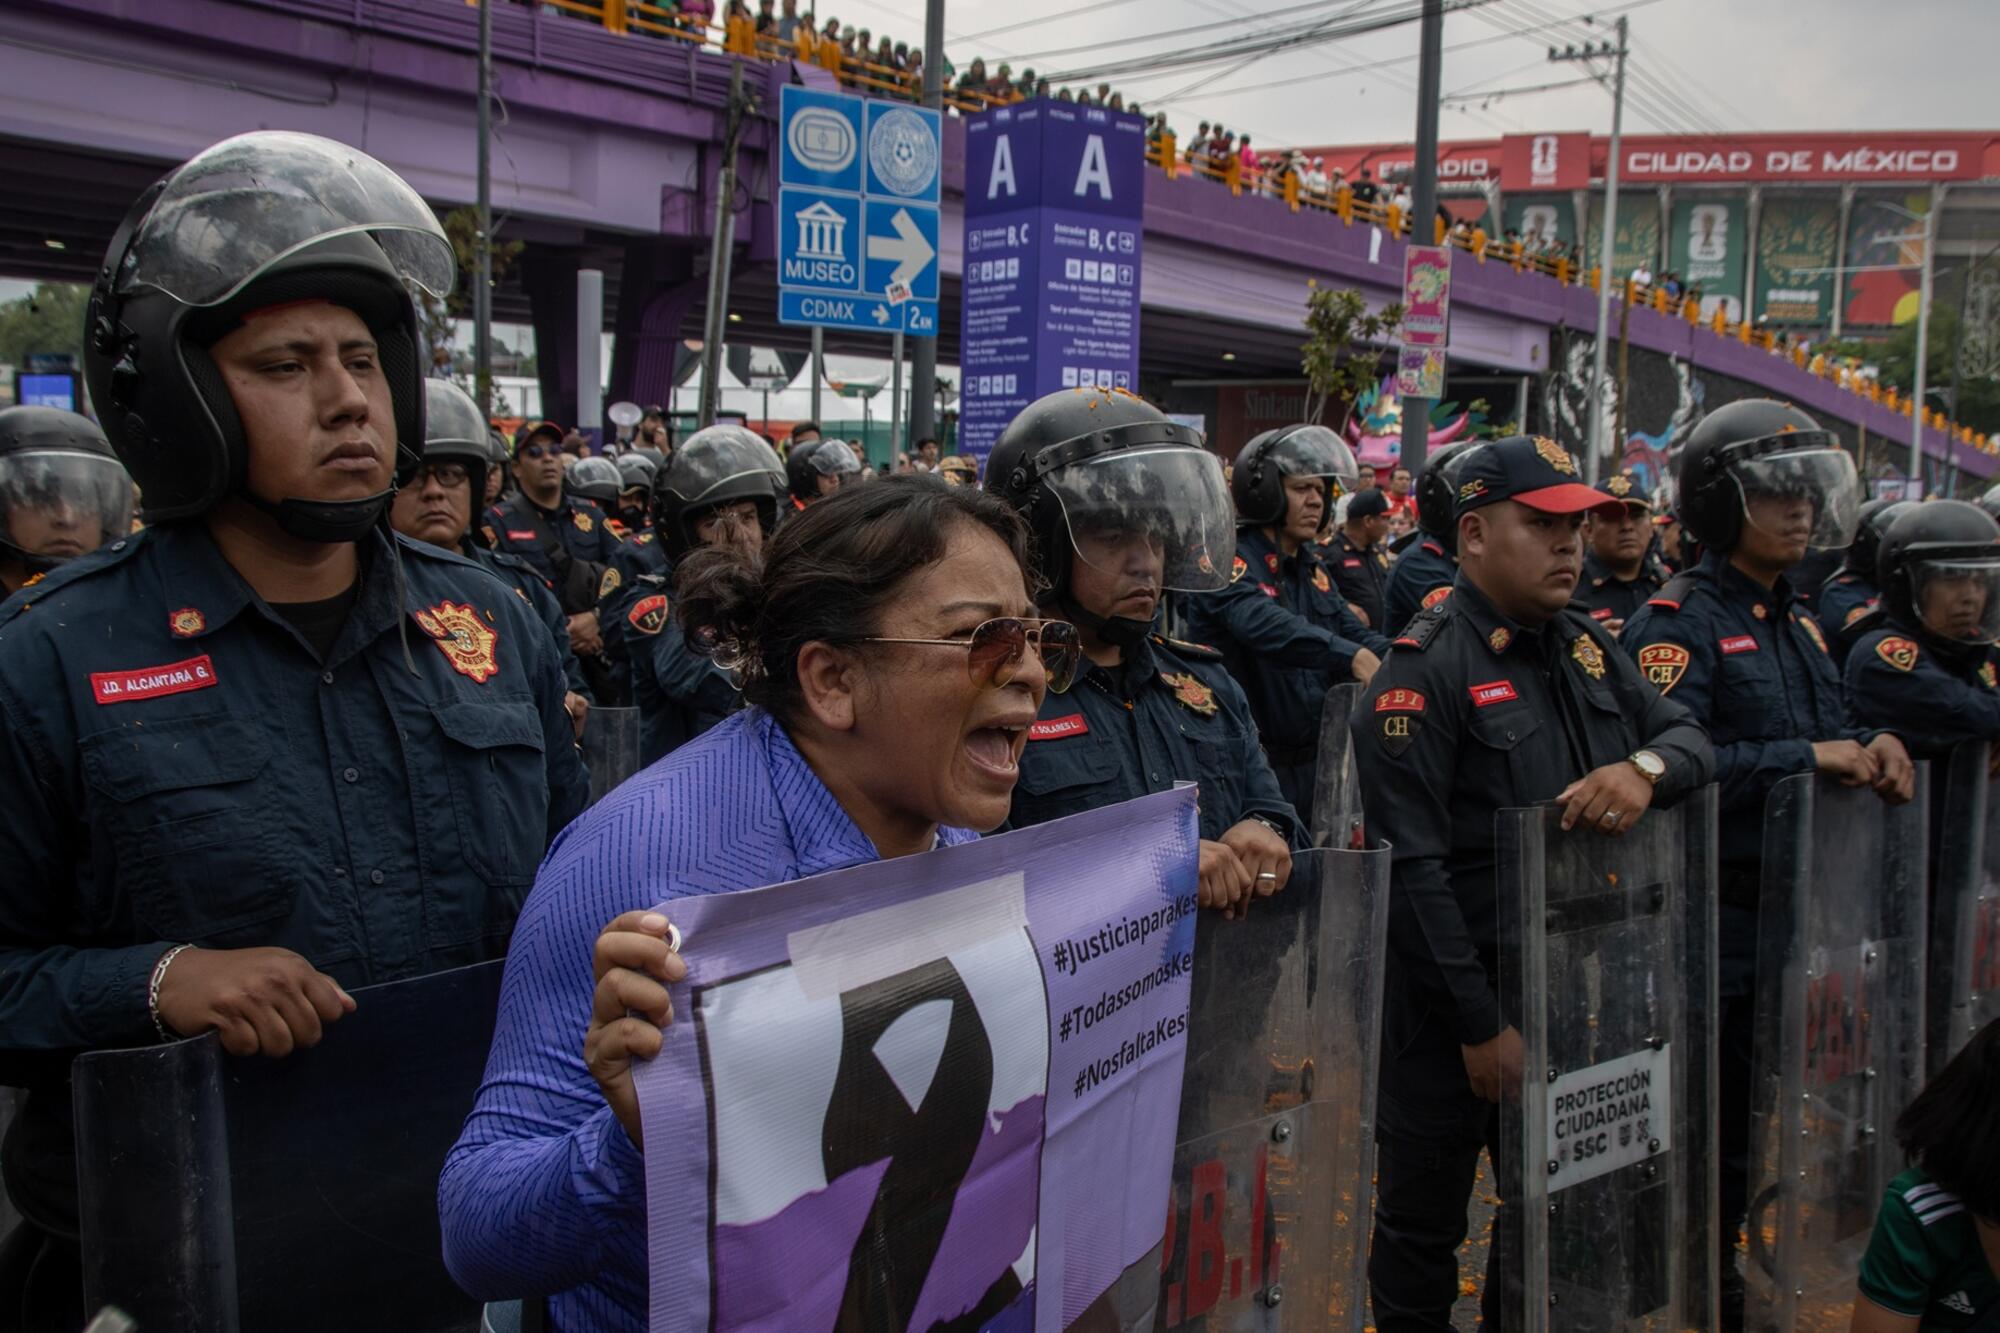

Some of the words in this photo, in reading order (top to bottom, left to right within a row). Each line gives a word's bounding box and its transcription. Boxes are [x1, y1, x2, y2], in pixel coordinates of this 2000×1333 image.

[987, 134, 1016, 199] A
[1074, 134, 1113, 200] A
[1379, 158, 1488, 178] ESDIO
[1627, 151, 1752, 173] CIUDAD
[1766, 151, 1812, 172] DE
[1823, 146, 1959, 172] MÉXICO
[1020, 222, 1029, 244] C
[1054, 223, 1087, 237] Entradas
[1105, 230, 1117, 252] C
[785, 258, 854, 284] MUSEO
[801, 298, 854, 320] CDMX
[1460, 479, 1484, 497] SSC
[1643, 648, 1684, 664] PBI
[102, 681, 122, 694] J.D.
[126, 670, 193, 692] ALCANTARA
[196, 665, 210, 678] G.
[1649, 666, 1675, 684] CH
[1380, 690, 1421, 707] PBI
[1384, 716, 1410, 736] CH
[1059, 951, 1193, 1044] #TodassomosKe
[1073, 1004, 1189, 1100] #NosfaltaKesi
[1555, 1067, 1650, 1116] PROTECCIÓN
[1555, 1093, 1650, 1140] CIUDADANA
[1573, 1132, 1607, 1162] SSC
